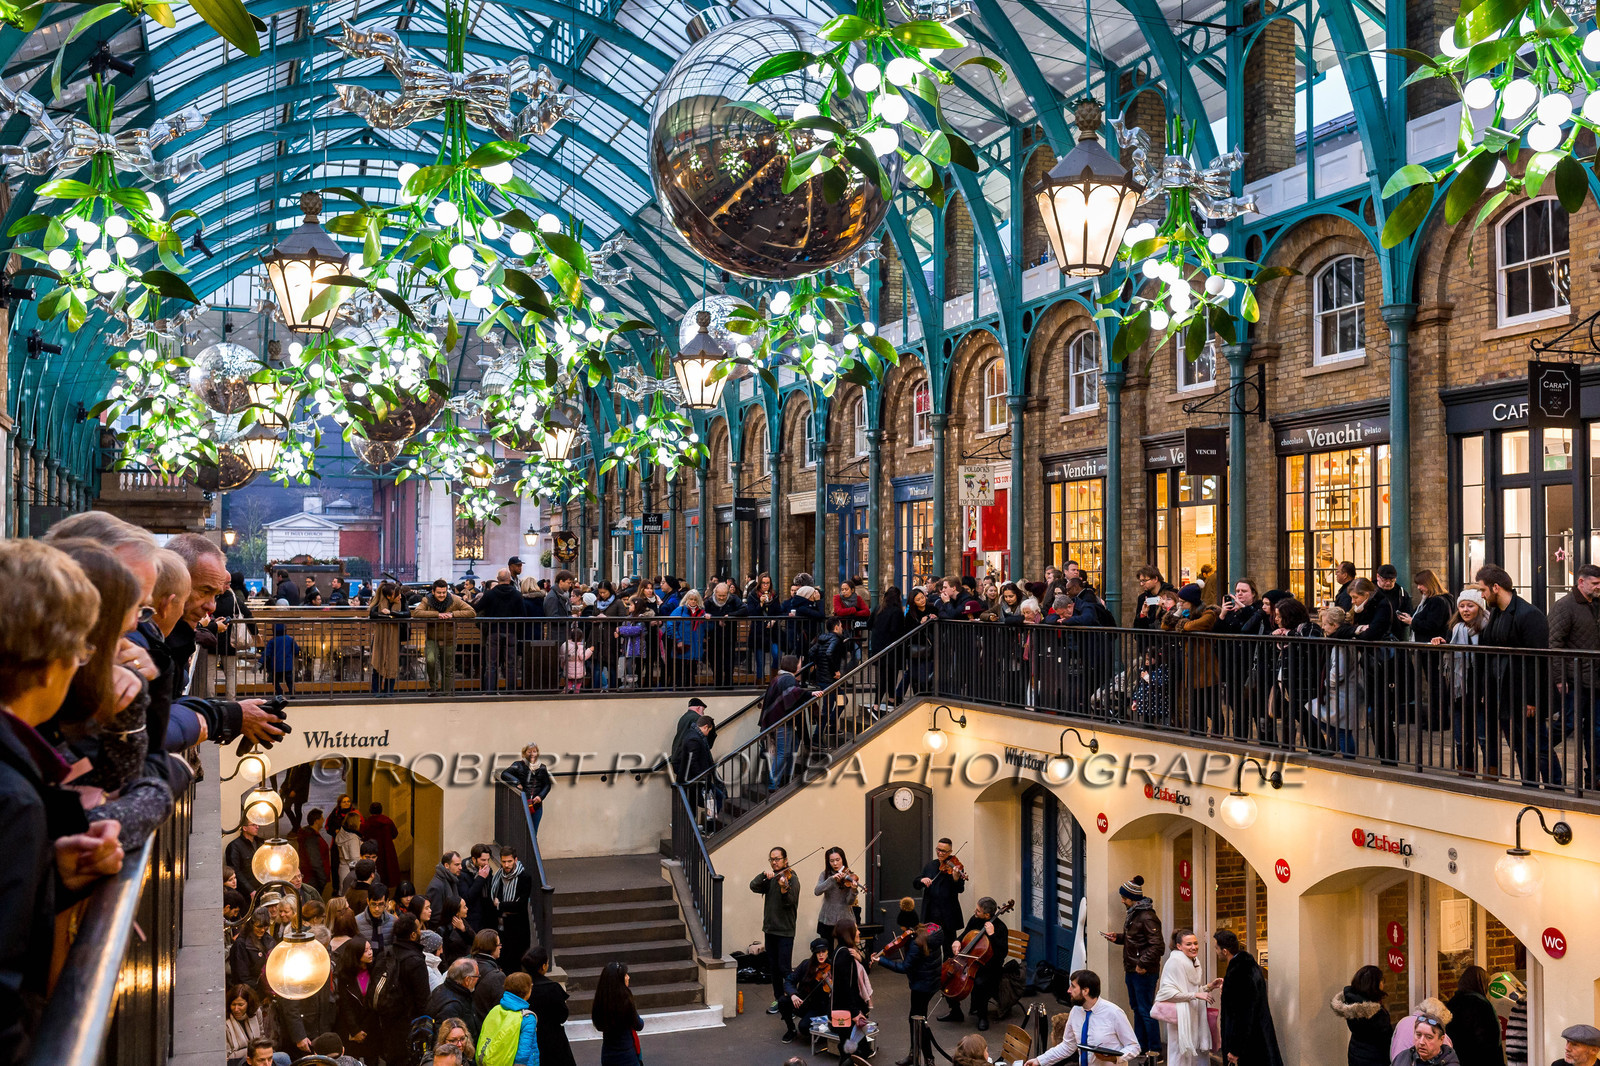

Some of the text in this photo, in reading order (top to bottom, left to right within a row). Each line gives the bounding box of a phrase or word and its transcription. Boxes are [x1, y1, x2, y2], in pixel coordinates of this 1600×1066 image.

[1280, 422, 1382, 448] chocolate Venchi gelato
[1149, 448, 1186, 465] chocolate Ve
[1062, 460, 1097, 478] Venchi
[303, 729, 390, 748] Whittard
[1005, 747, 1049, 773] Whittard
[1097, 818, 1107, 828] WC
[1275, 864, 1289, 877] WC
[1180, 885, 1191, 897] WC
[1544, 934, 1564, 951] WC
[1388, 953, 1404, 967] WC
